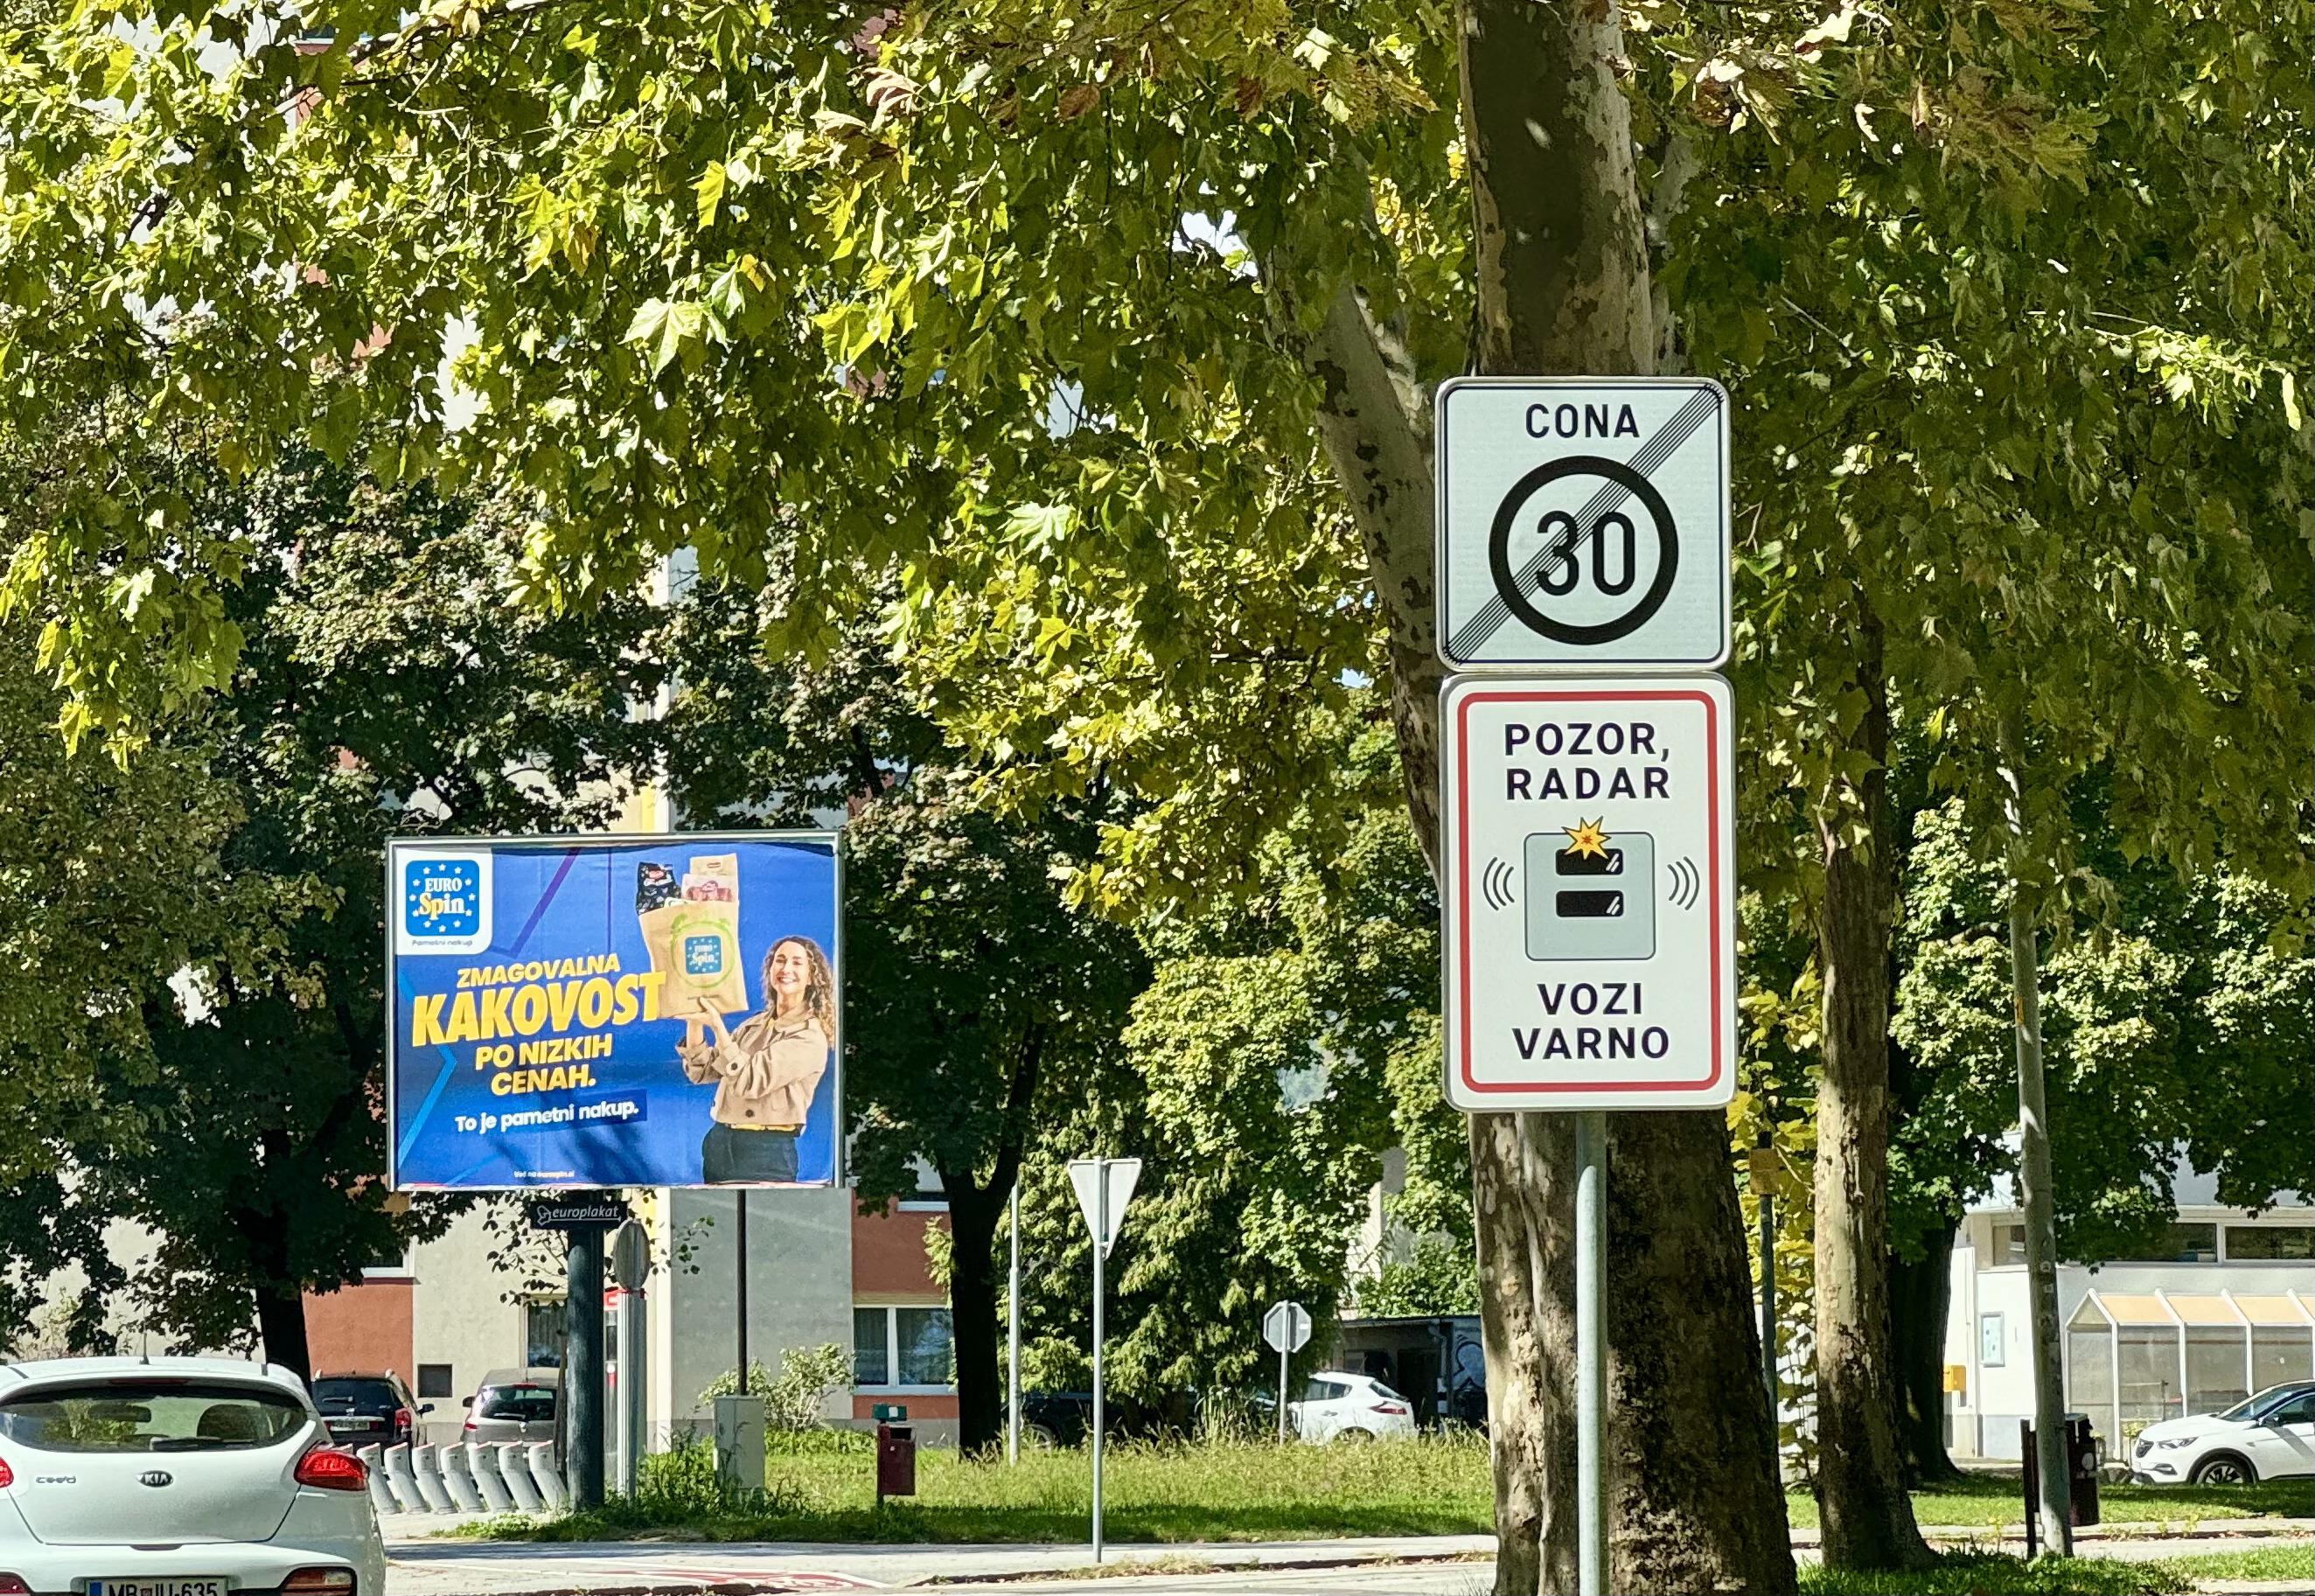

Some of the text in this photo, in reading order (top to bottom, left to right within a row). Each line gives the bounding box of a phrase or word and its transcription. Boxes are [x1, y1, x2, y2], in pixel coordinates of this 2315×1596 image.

[1525, 403, 1641, 439] CONA
[1537, 510, 1635, 596] 30
[1504, 722, 1670, 763] POZOR,
[1506, 766, 1670, 801] RADAR
[424, 877, 464, 893] EURO
[418, 892, 466, 921] Spin
[456, 952, 621, 989] ZMAGOVALNA
[412, 971, 666, 1048] KAKOVOST
[1537, 982, 1642, 1016] VOZI
[475, 1033, 613, 1071] PO NIZKIH
[1511, 1026, 1670, 1060] VARNO
[491, 1063, 596, 1097] CENAH.
[455, 1099, 640, 1135] To je pametni nakup.
[552, 1204, 619, 1220] europlakat
[144, 1473, 169, 1485] KIA
